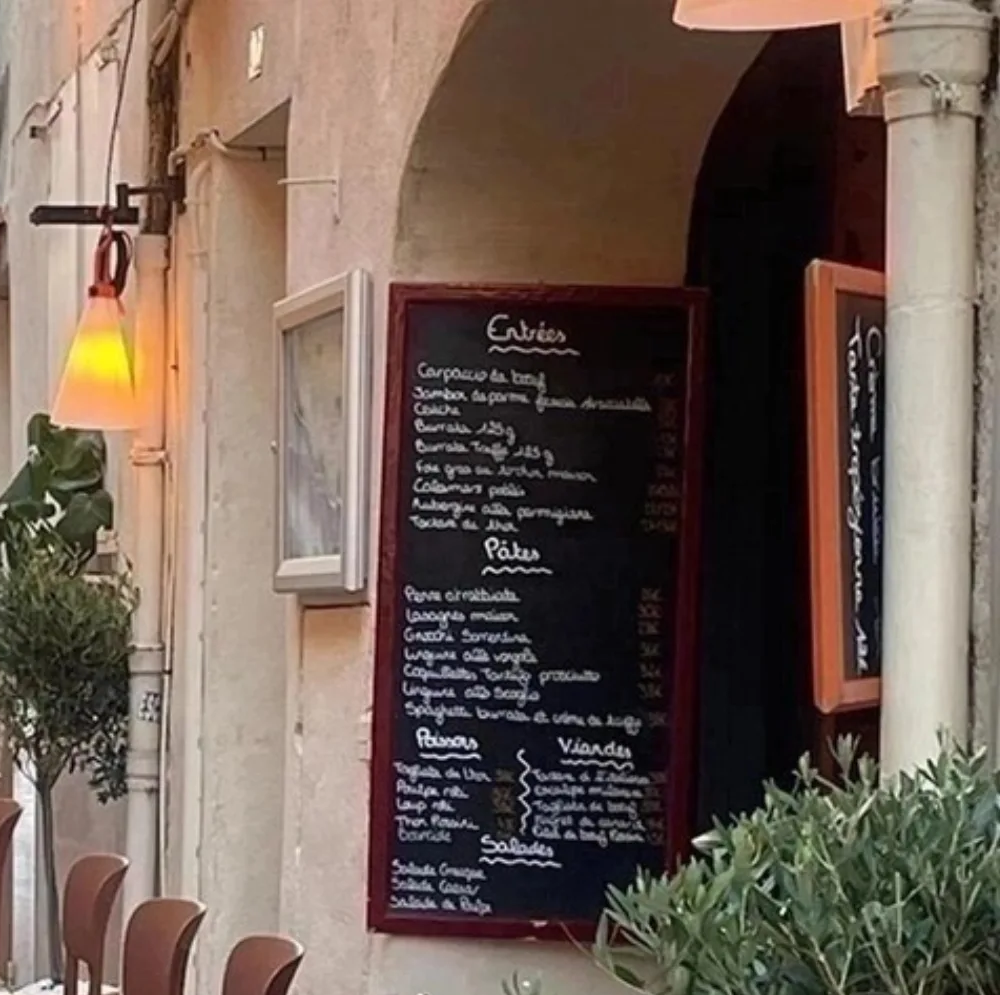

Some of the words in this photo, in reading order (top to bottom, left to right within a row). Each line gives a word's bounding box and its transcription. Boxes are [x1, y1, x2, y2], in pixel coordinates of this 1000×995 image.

[486, 313, 567, 343] Entrées
[484, 536, 541, 562] Pâtes
[557, 736, 632, 759] Viandes
[480, 834, 554, 858] Salades
